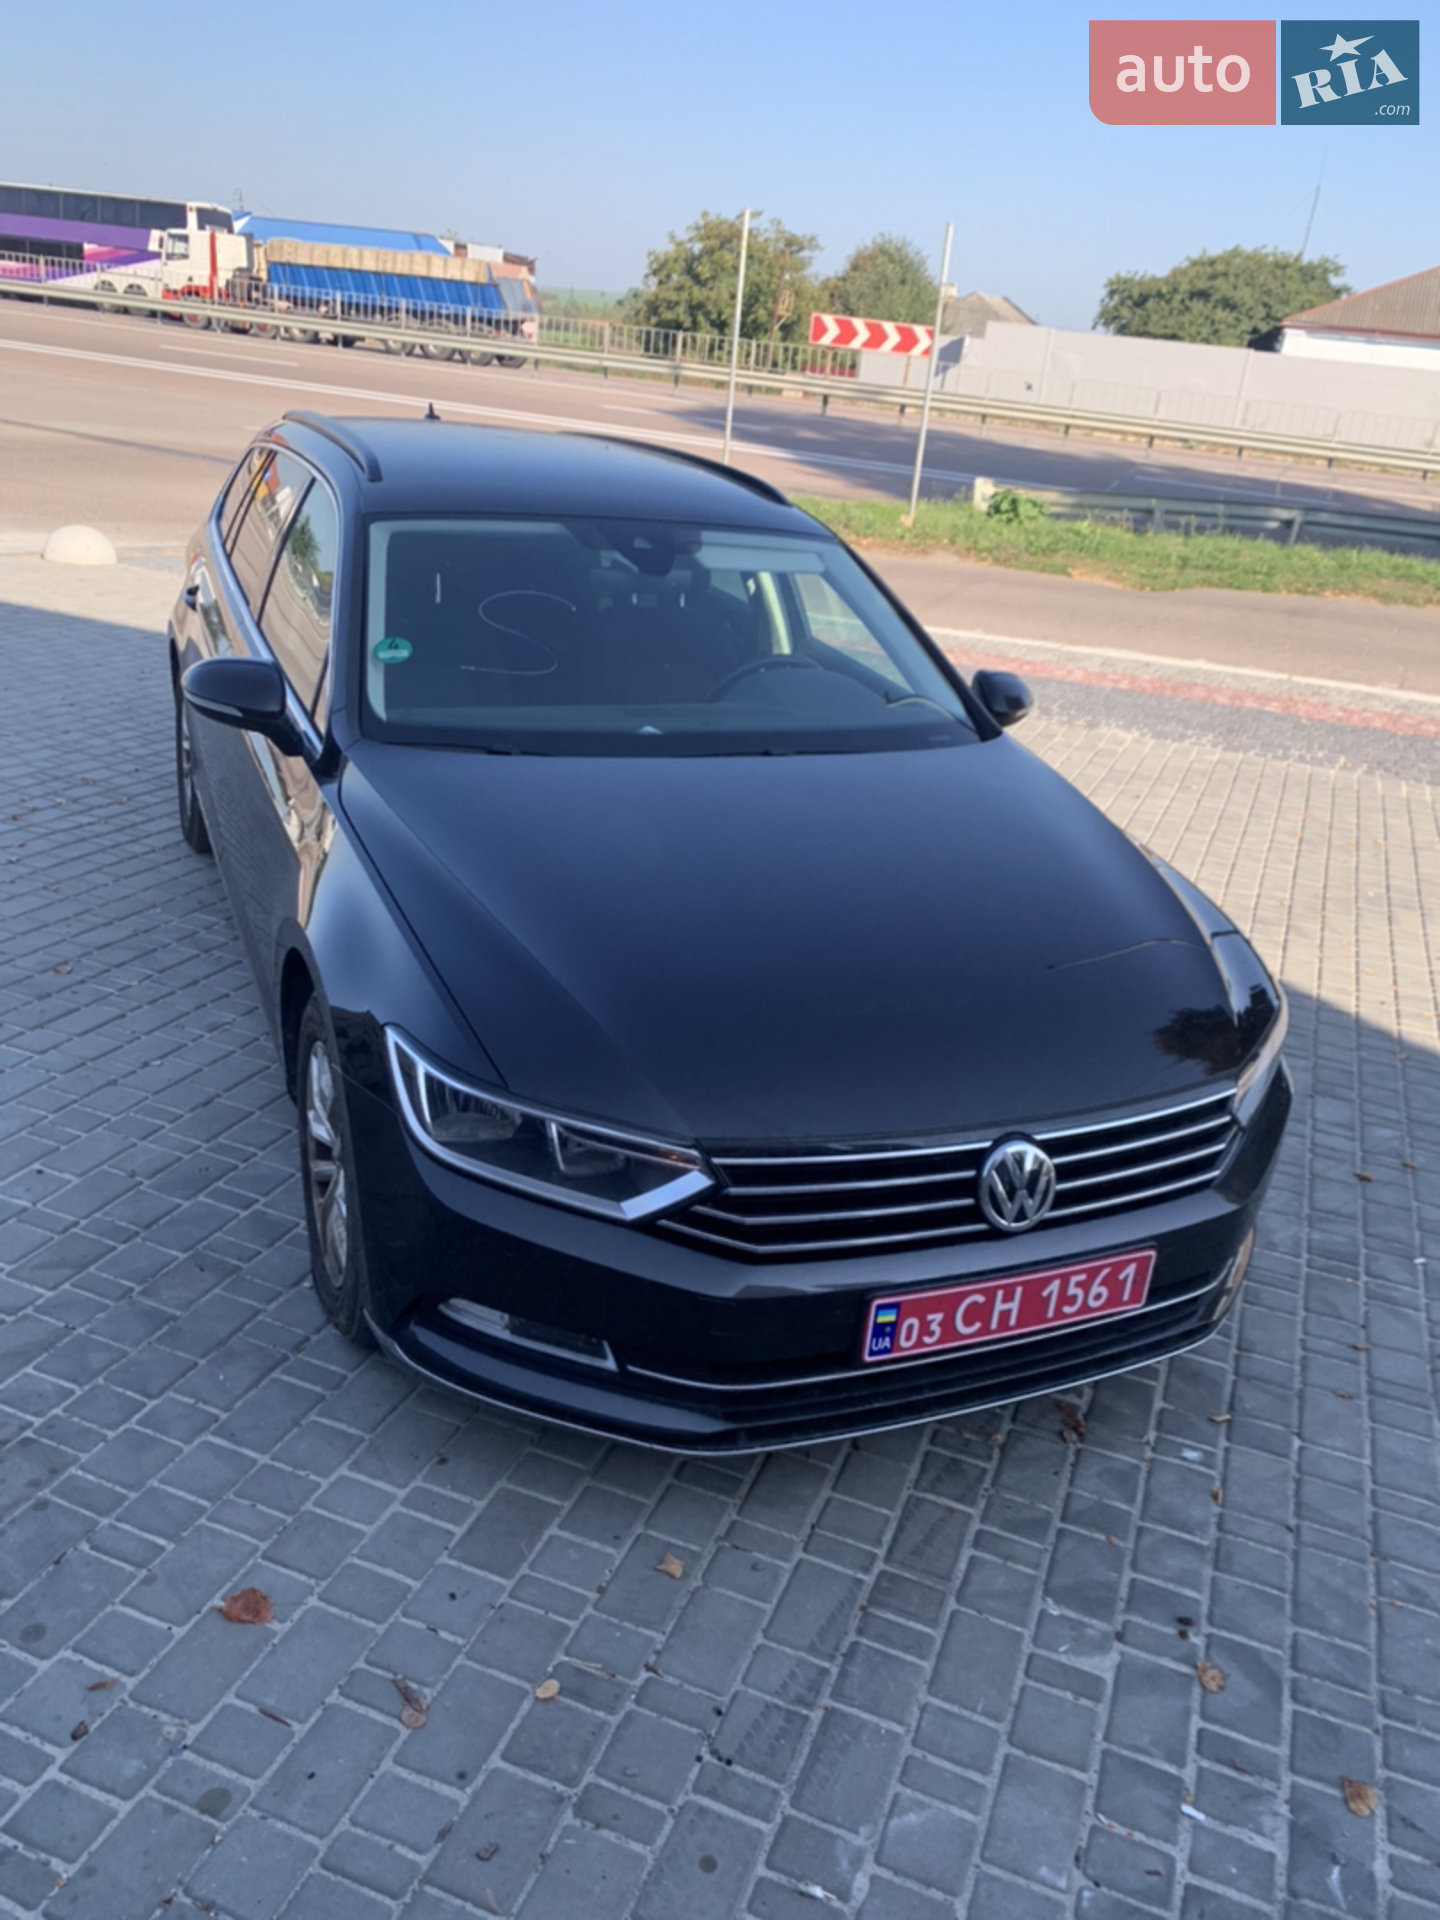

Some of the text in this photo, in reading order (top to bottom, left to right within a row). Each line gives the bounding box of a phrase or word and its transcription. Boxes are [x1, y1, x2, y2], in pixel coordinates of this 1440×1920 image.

[899, 1262, 1137, 1349] 03 CH 1561
[871, 1336, 892, 1351] UA
